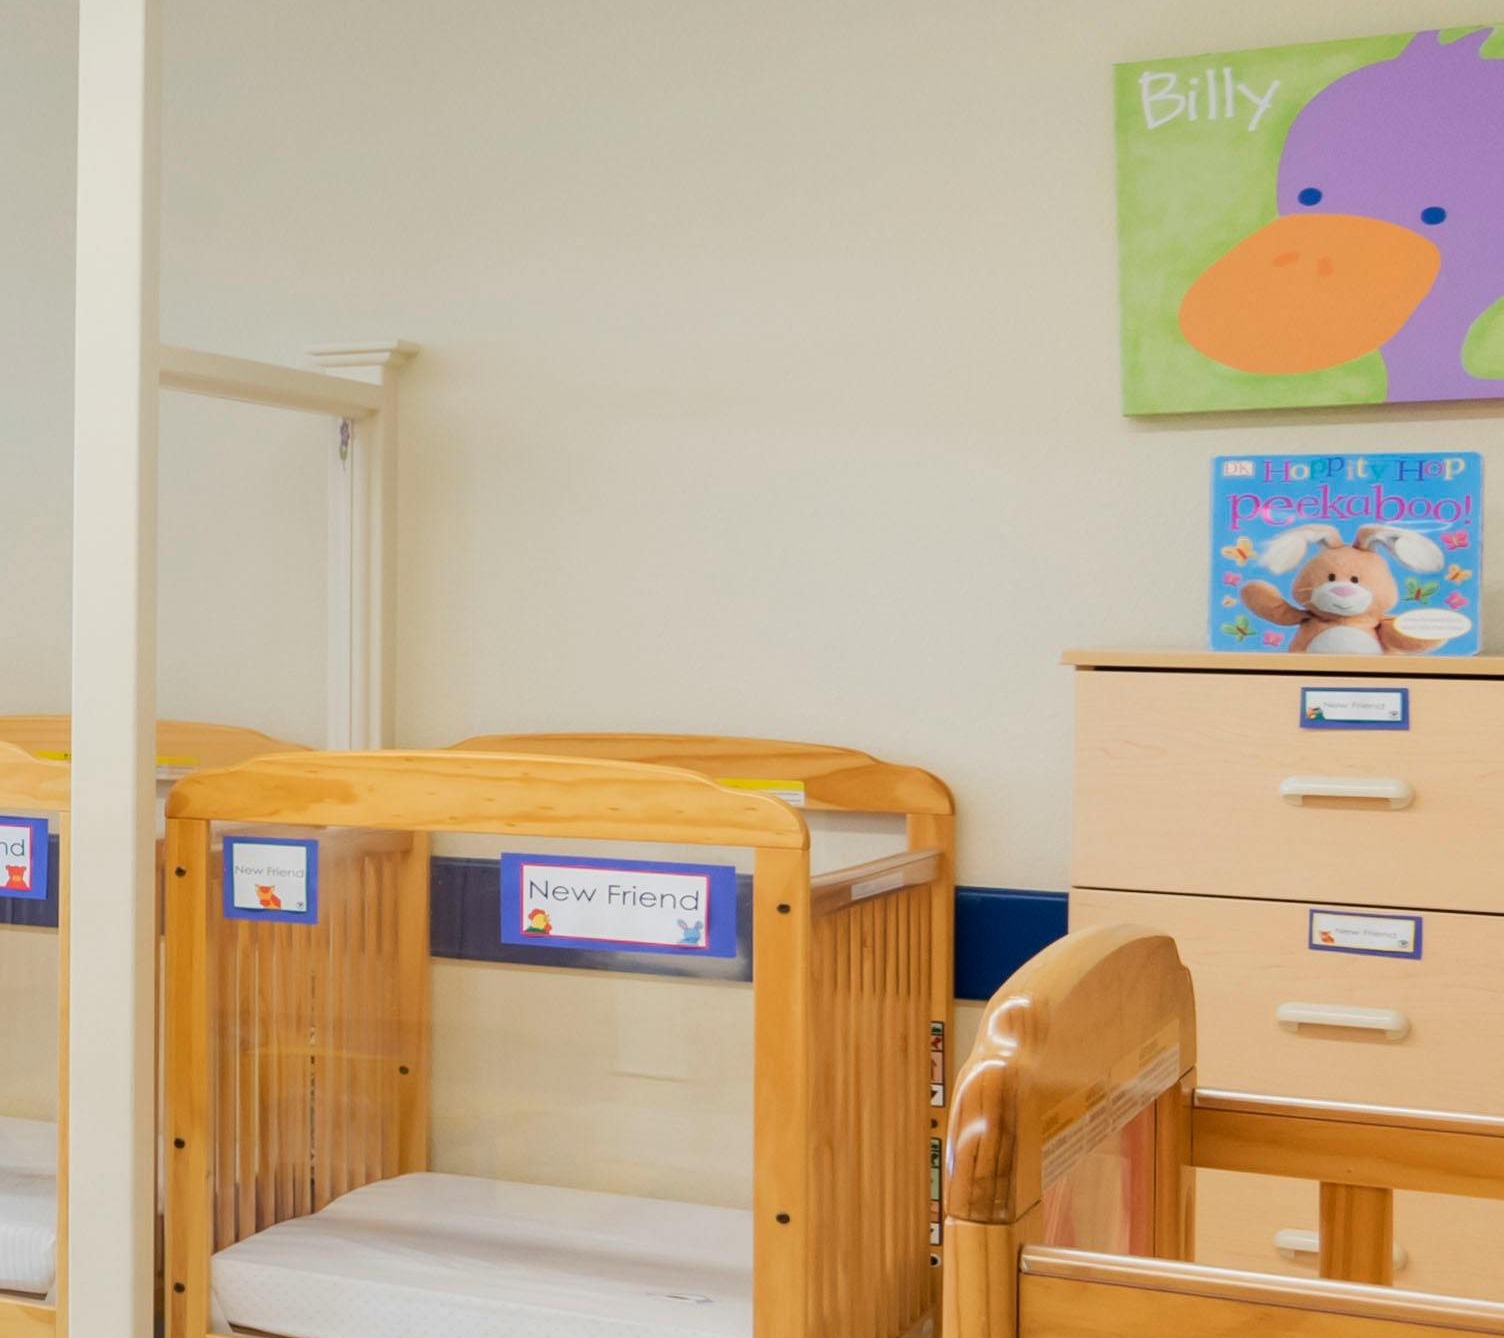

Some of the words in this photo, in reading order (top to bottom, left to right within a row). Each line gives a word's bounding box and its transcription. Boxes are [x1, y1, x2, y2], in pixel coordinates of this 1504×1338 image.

[1138, 66, 1281, 132] Billy
[1263, 457, 1387, 483] Hoppity
[1396, 458, 1465, 482] Hop
[1226, 483, 1473, 531] peekaboo!
[234, 864, 264, 877] New
[266, 864, 305, 879] Friend
[529, 879, 597, 904] New
[607, 883, 700, 912] Friend
